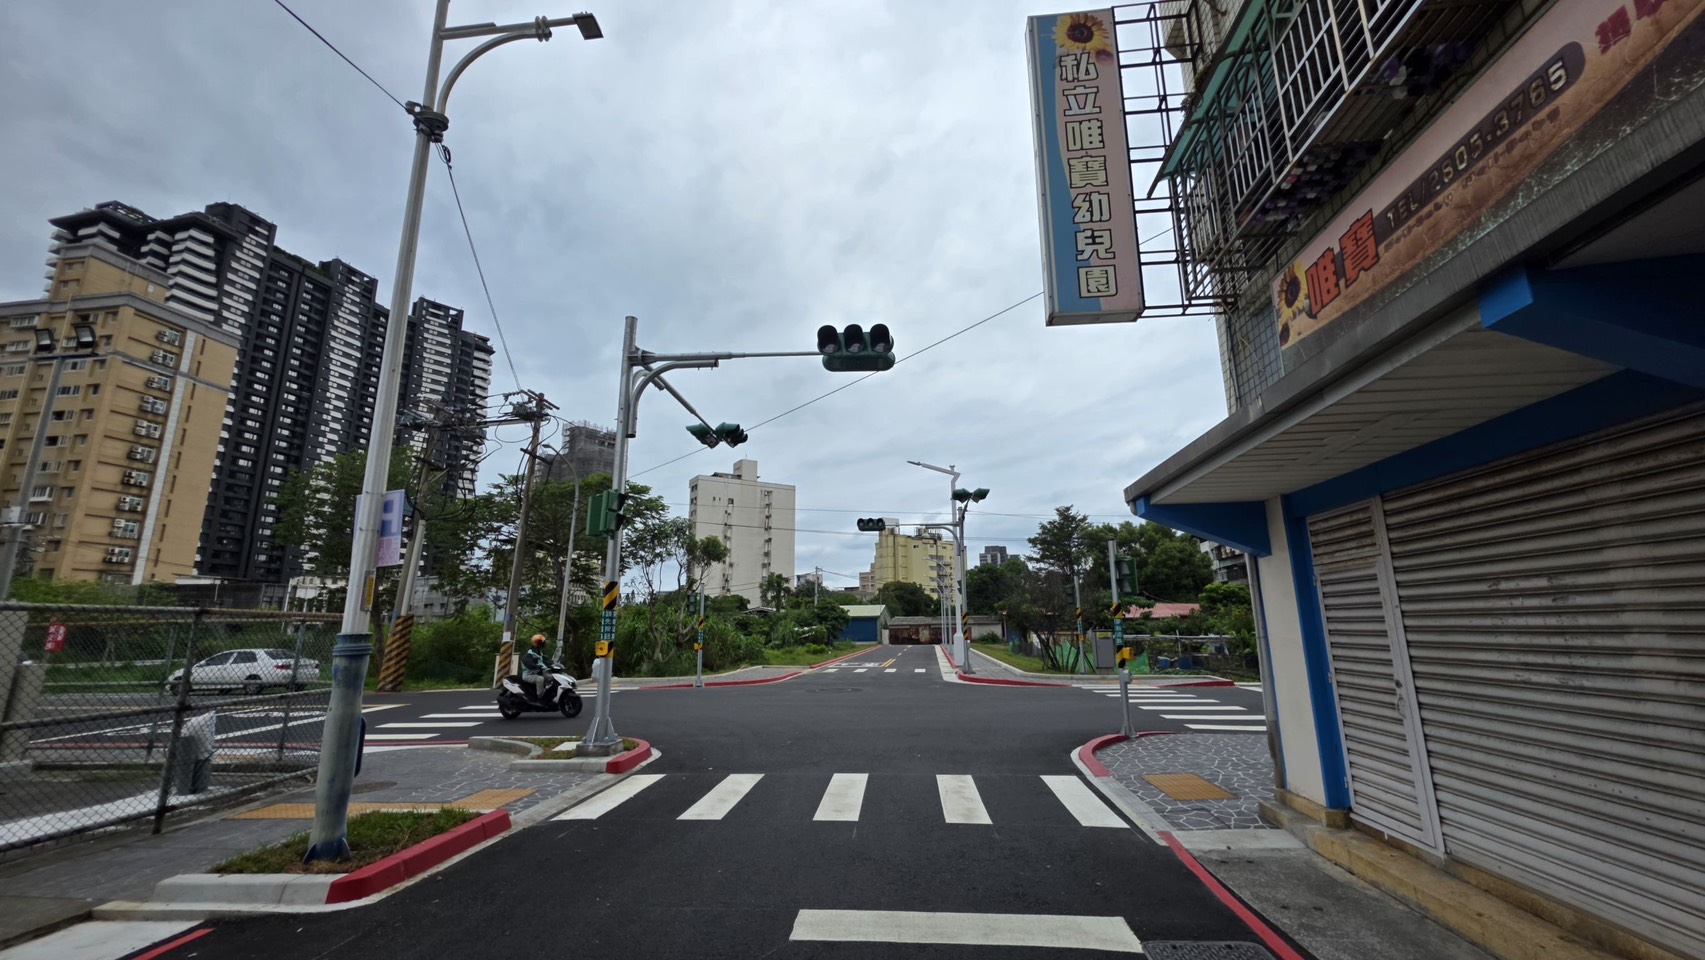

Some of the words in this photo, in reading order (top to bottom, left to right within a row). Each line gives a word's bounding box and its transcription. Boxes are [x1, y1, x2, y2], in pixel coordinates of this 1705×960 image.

[1059, 52, 1118, 298] 私立唯寶幼兒園
[1305, 208, 1380, 316] 唯寶
